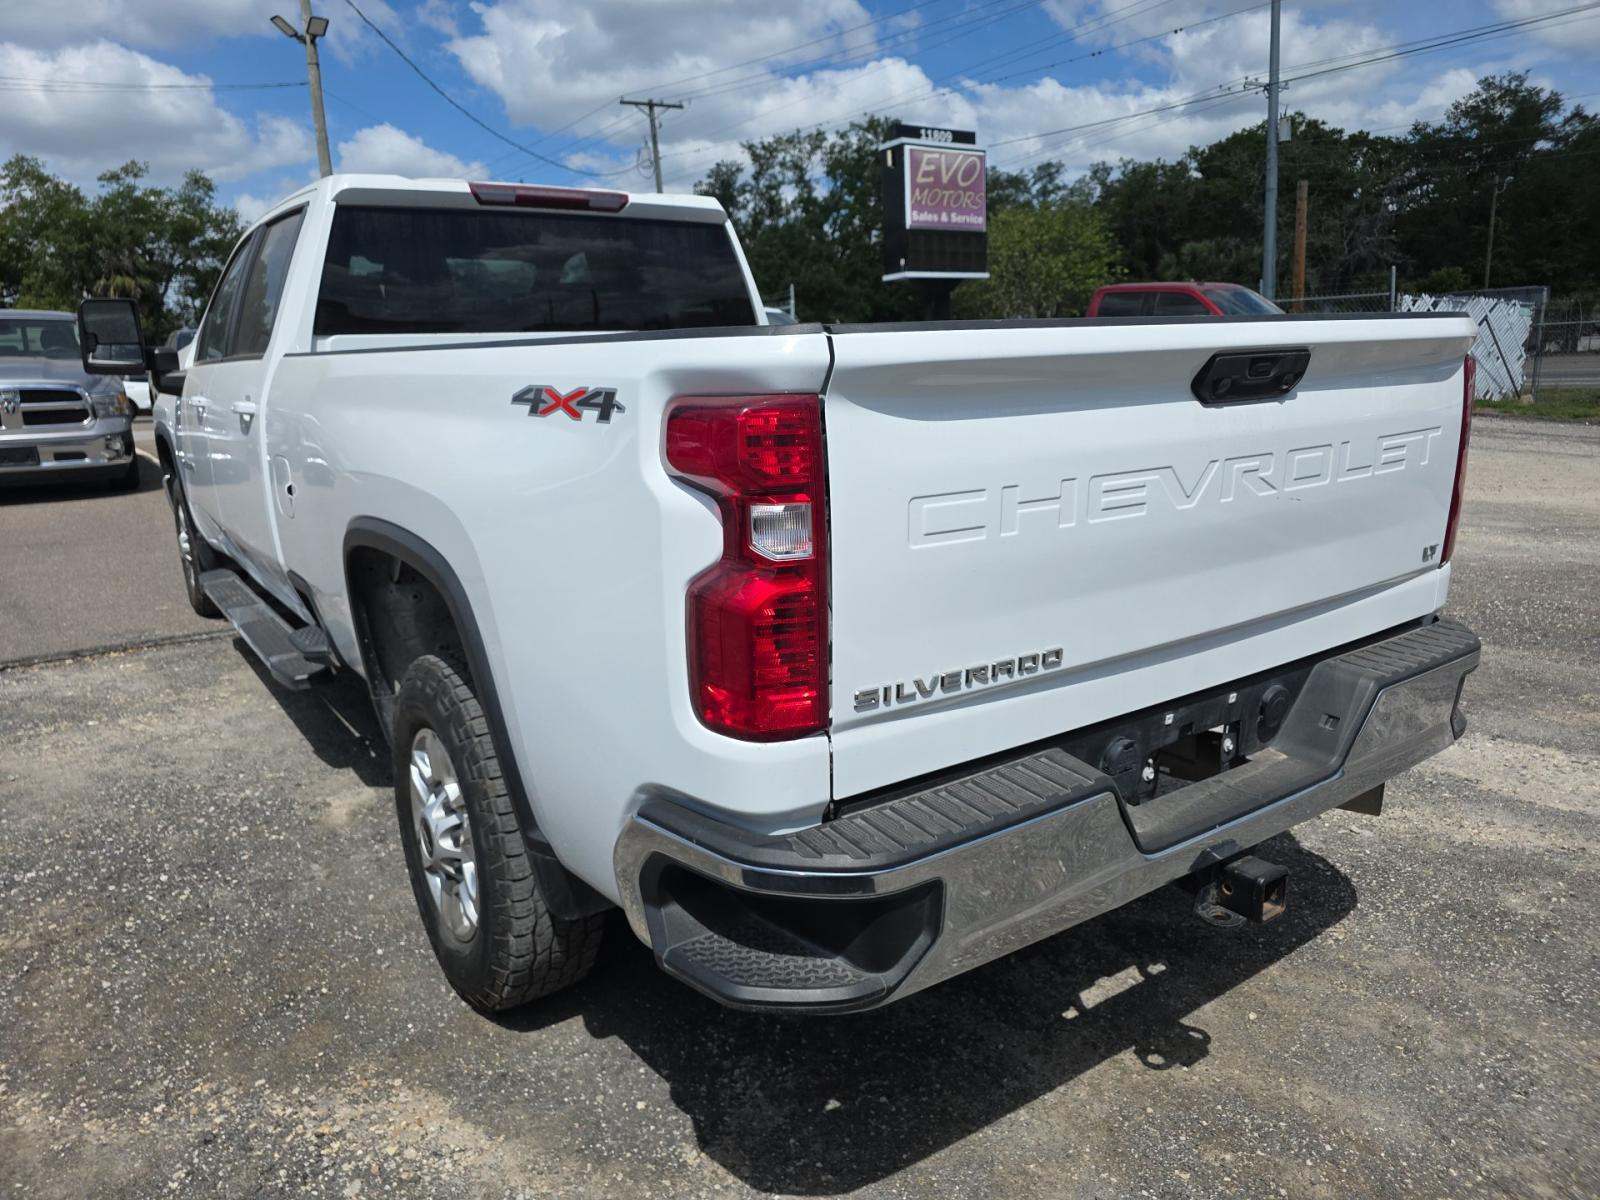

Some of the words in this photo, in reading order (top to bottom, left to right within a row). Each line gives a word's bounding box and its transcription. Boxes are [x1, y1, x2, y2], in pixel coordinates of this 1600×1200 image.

[916, 153, 980, 187] EVO
[911, 187, 984, 209] MOTORS
[912, 210, 938, 222] Sales
[940, 212, 949, 223] &
[950, 212, 983, 225] Service
[908, 426, 1442, 549] CHEVROLET
[1422, 544, 1440, 563] LT
[853, 647, 1064, 713] SILVERADO
